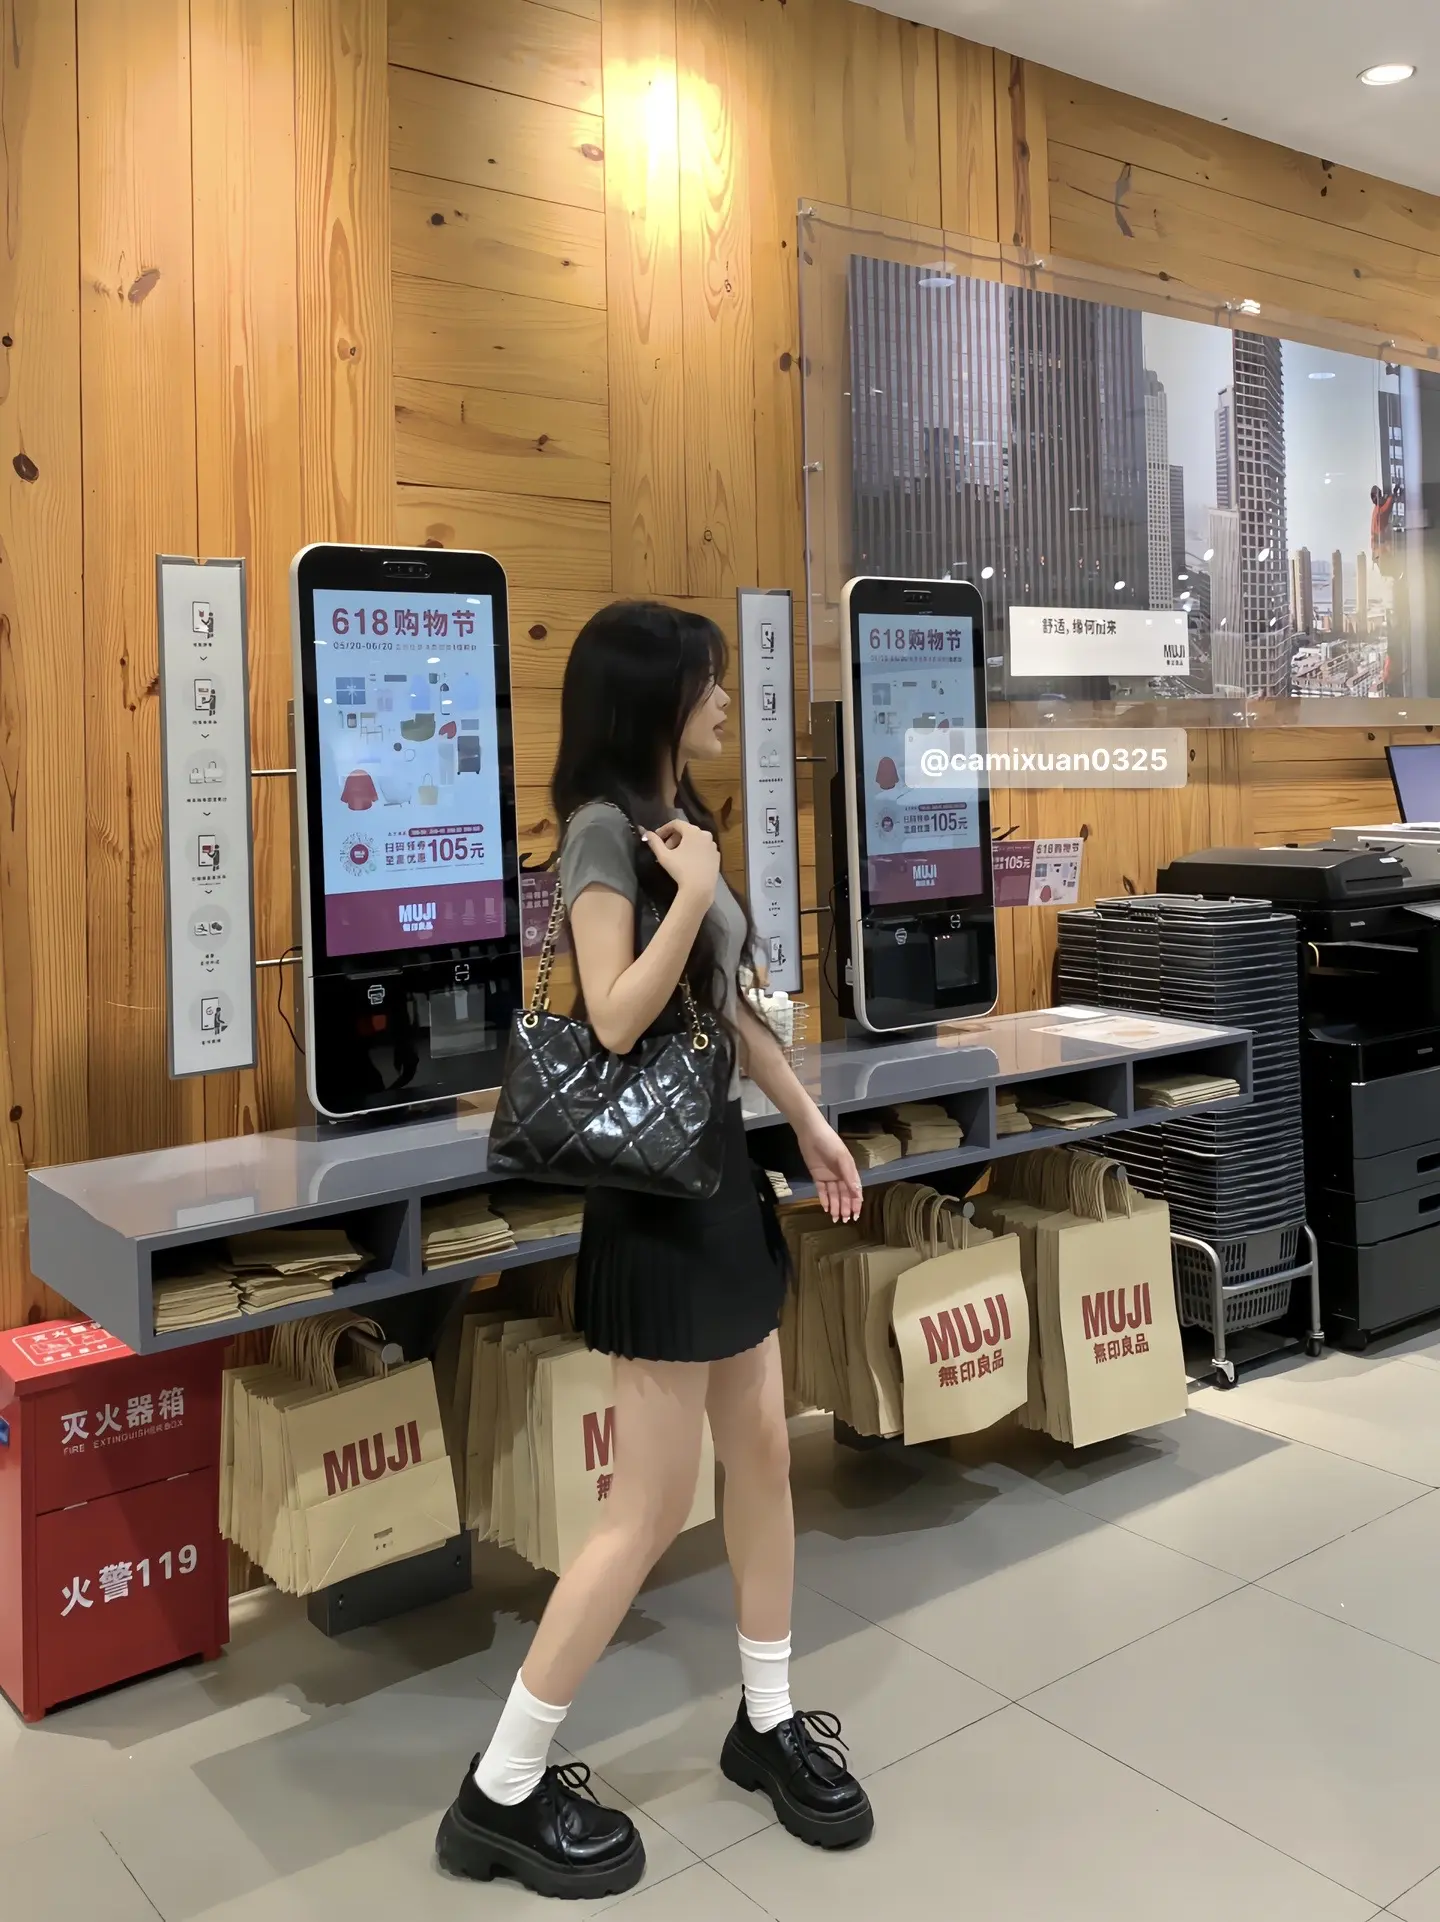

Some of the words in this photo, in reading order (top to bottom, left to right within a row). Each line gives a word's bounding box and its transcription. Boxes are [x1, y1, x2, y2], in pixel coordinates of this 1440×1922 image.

[332, 607, 475, 638] 618购物节
[869, 628, 962, 651] 618购物节
[1163, 644, 1186, 658] MUJI
[930, 812, 968, 832] 105元
[428, 837, 484, 862] 105元
[912, 864, 937, 880] MUJI
[398, 902, 436, 923] MUJI
[1081, 1282, 1152, 1340] MUJI
[919, 1294, 1012, 1365] MUJI
[1093, 1333, 1149, 1364] 無印良品
[938, 1348, 1004, 1388] 無印良品
[61, 1387, 184, 1444] 灭火器箱
[63, 1443, 85, 1456] FIRE
[323, 1420, 422, 1496] MUJI
[60, 1544, 198, 1617] 火警119
